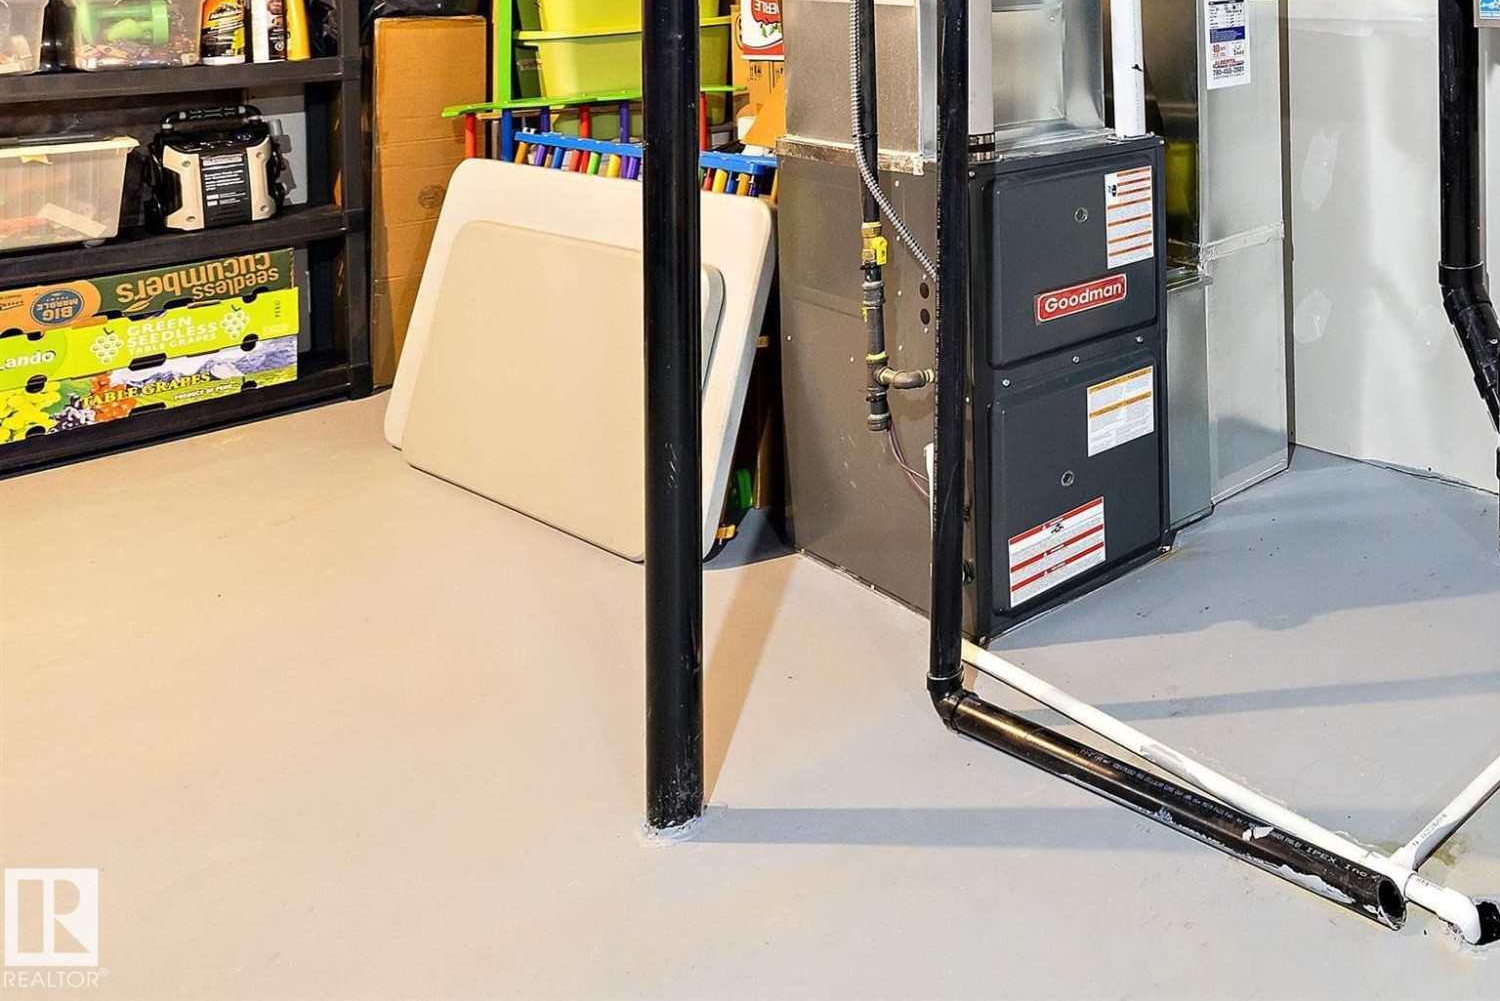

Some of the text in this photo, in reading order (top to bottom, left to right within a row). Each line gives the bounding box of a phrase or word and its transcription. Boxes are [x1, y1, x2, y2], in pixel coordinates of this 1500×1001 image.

[115, 252, 271, 303] cucumbers
[191, 267, 280, 300] seedless
[36, 298, 79, 311] MARBLE
[1044, 281, 1122, 313] Goodman
[42, 306, 73, 321] BIG
[127, 316, 192, 336] GREEN
[127, 321, 218, 348] SEEDLESS
[129, 333, 217, 355] TABLE GRAPES
[82, 372, 211, 408] TABLE GRAPES
[1306, 847, 1338, 864] IPEX
